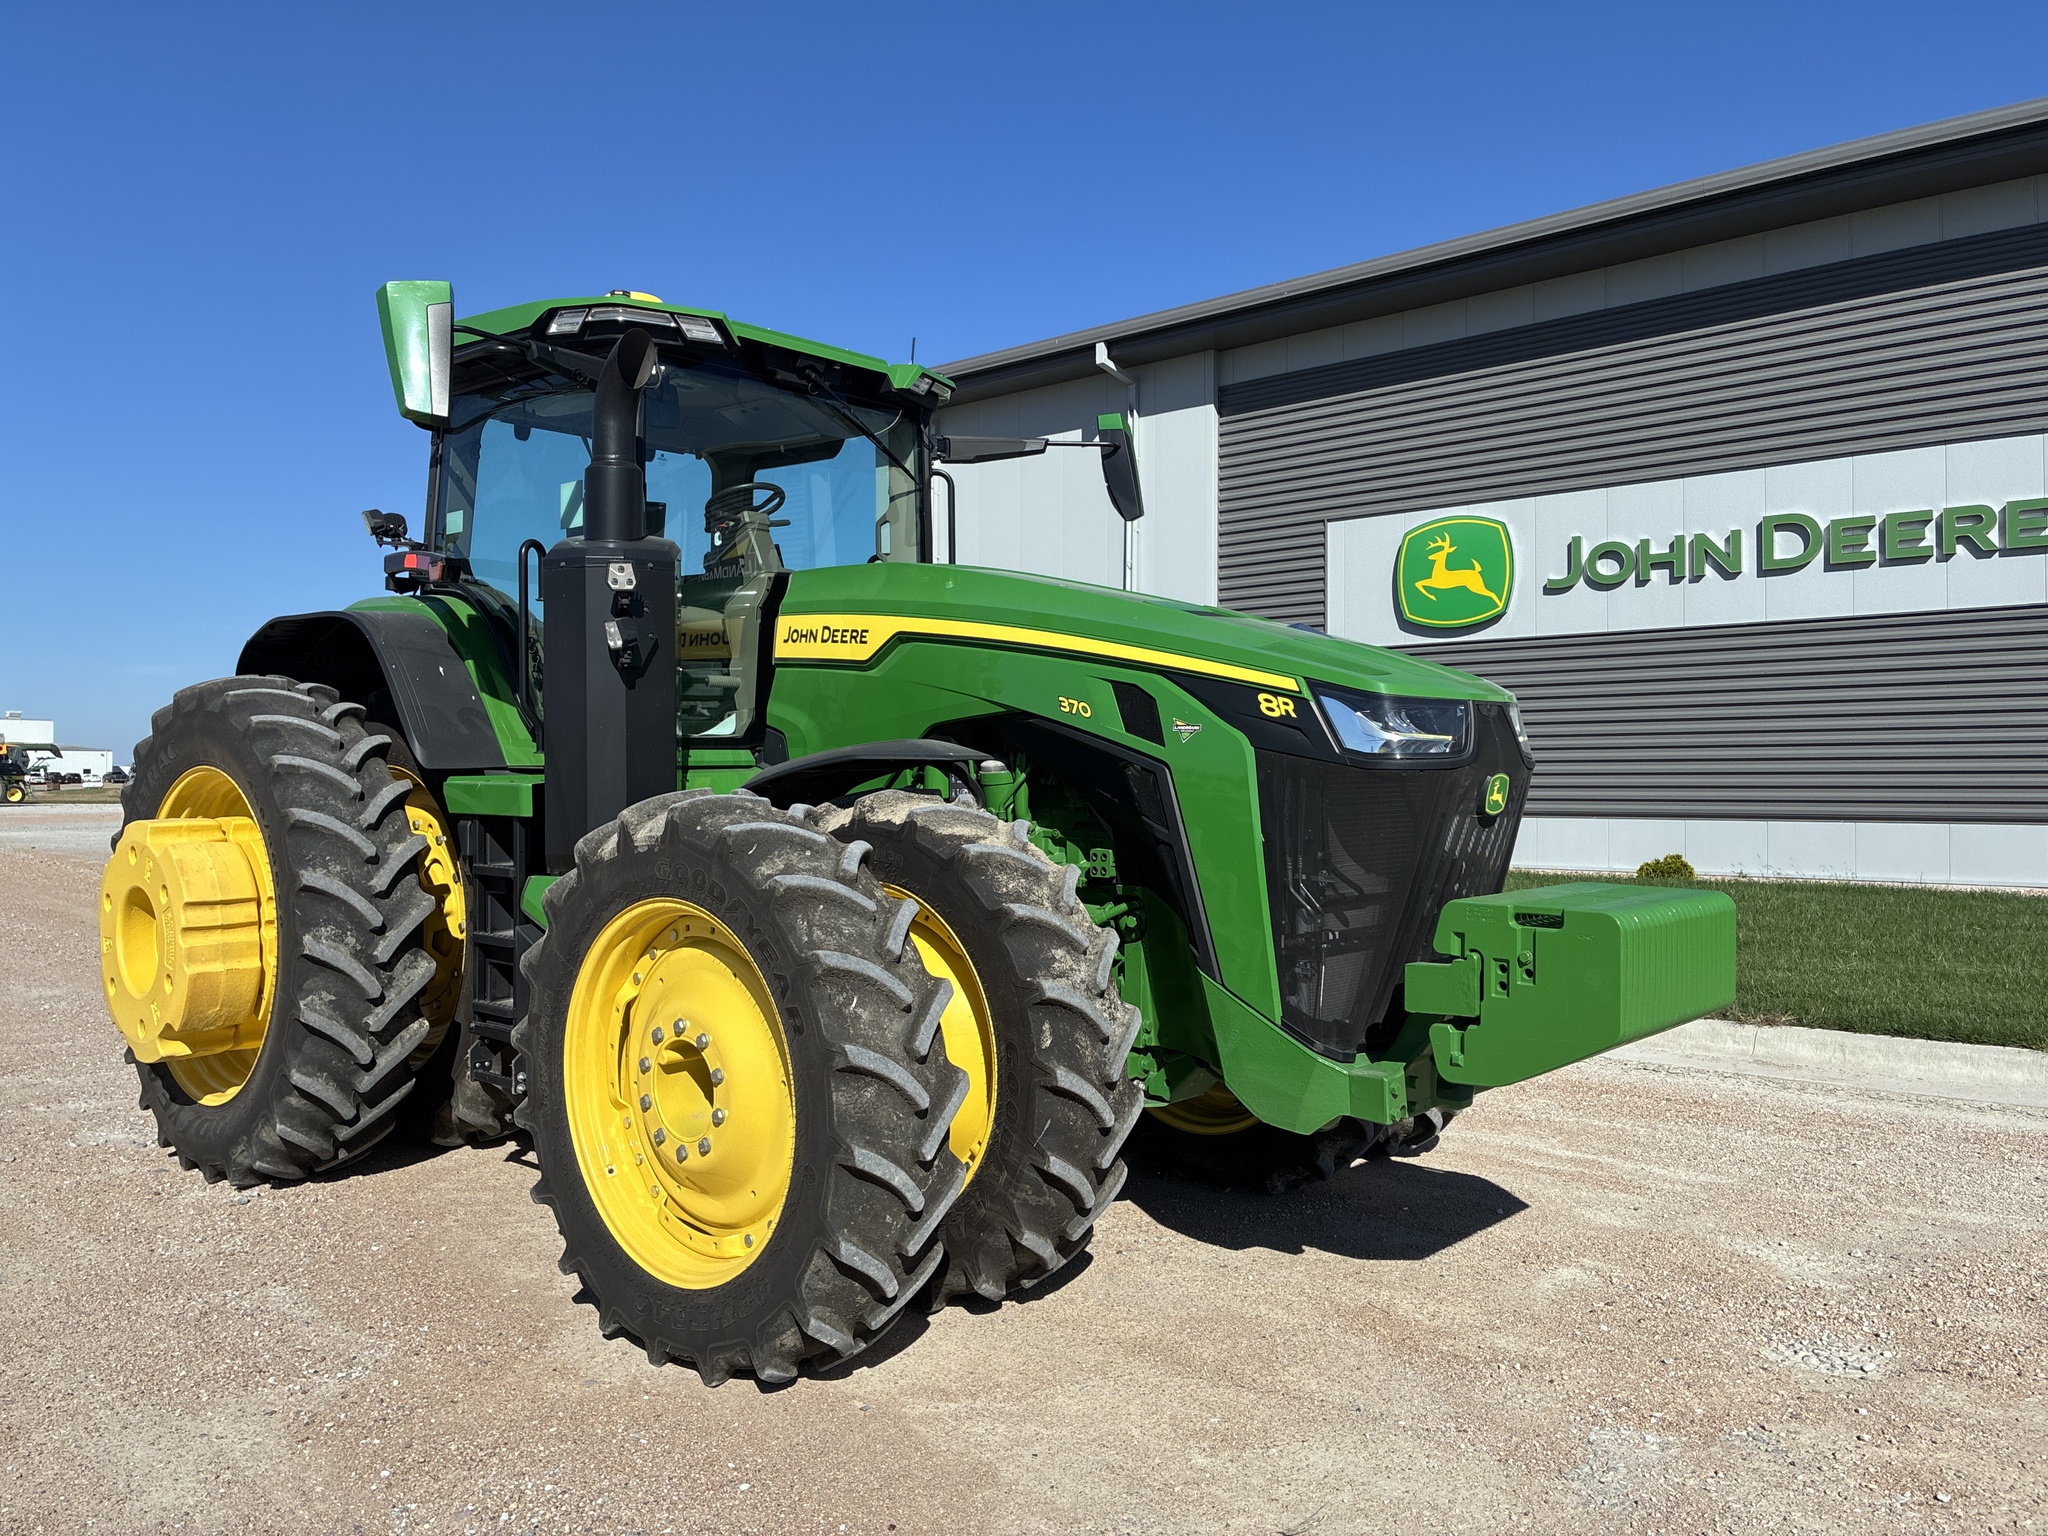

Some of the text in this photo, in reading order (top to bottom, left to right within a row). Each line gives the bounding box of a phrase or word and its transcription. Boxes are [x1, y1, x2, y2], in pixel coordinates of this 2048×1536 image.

[1542, 498, 2048, 593] JOHN DEERE
[783, 625, 869, 644] JOHN DEERE
[1058, 696, 1092, 718] 370
[1257, 692, 1297, 718] 8R
[654, 857, 806, 1037] GOODYEAR
[945, 1041, 1020, 1243] GOODYEA
